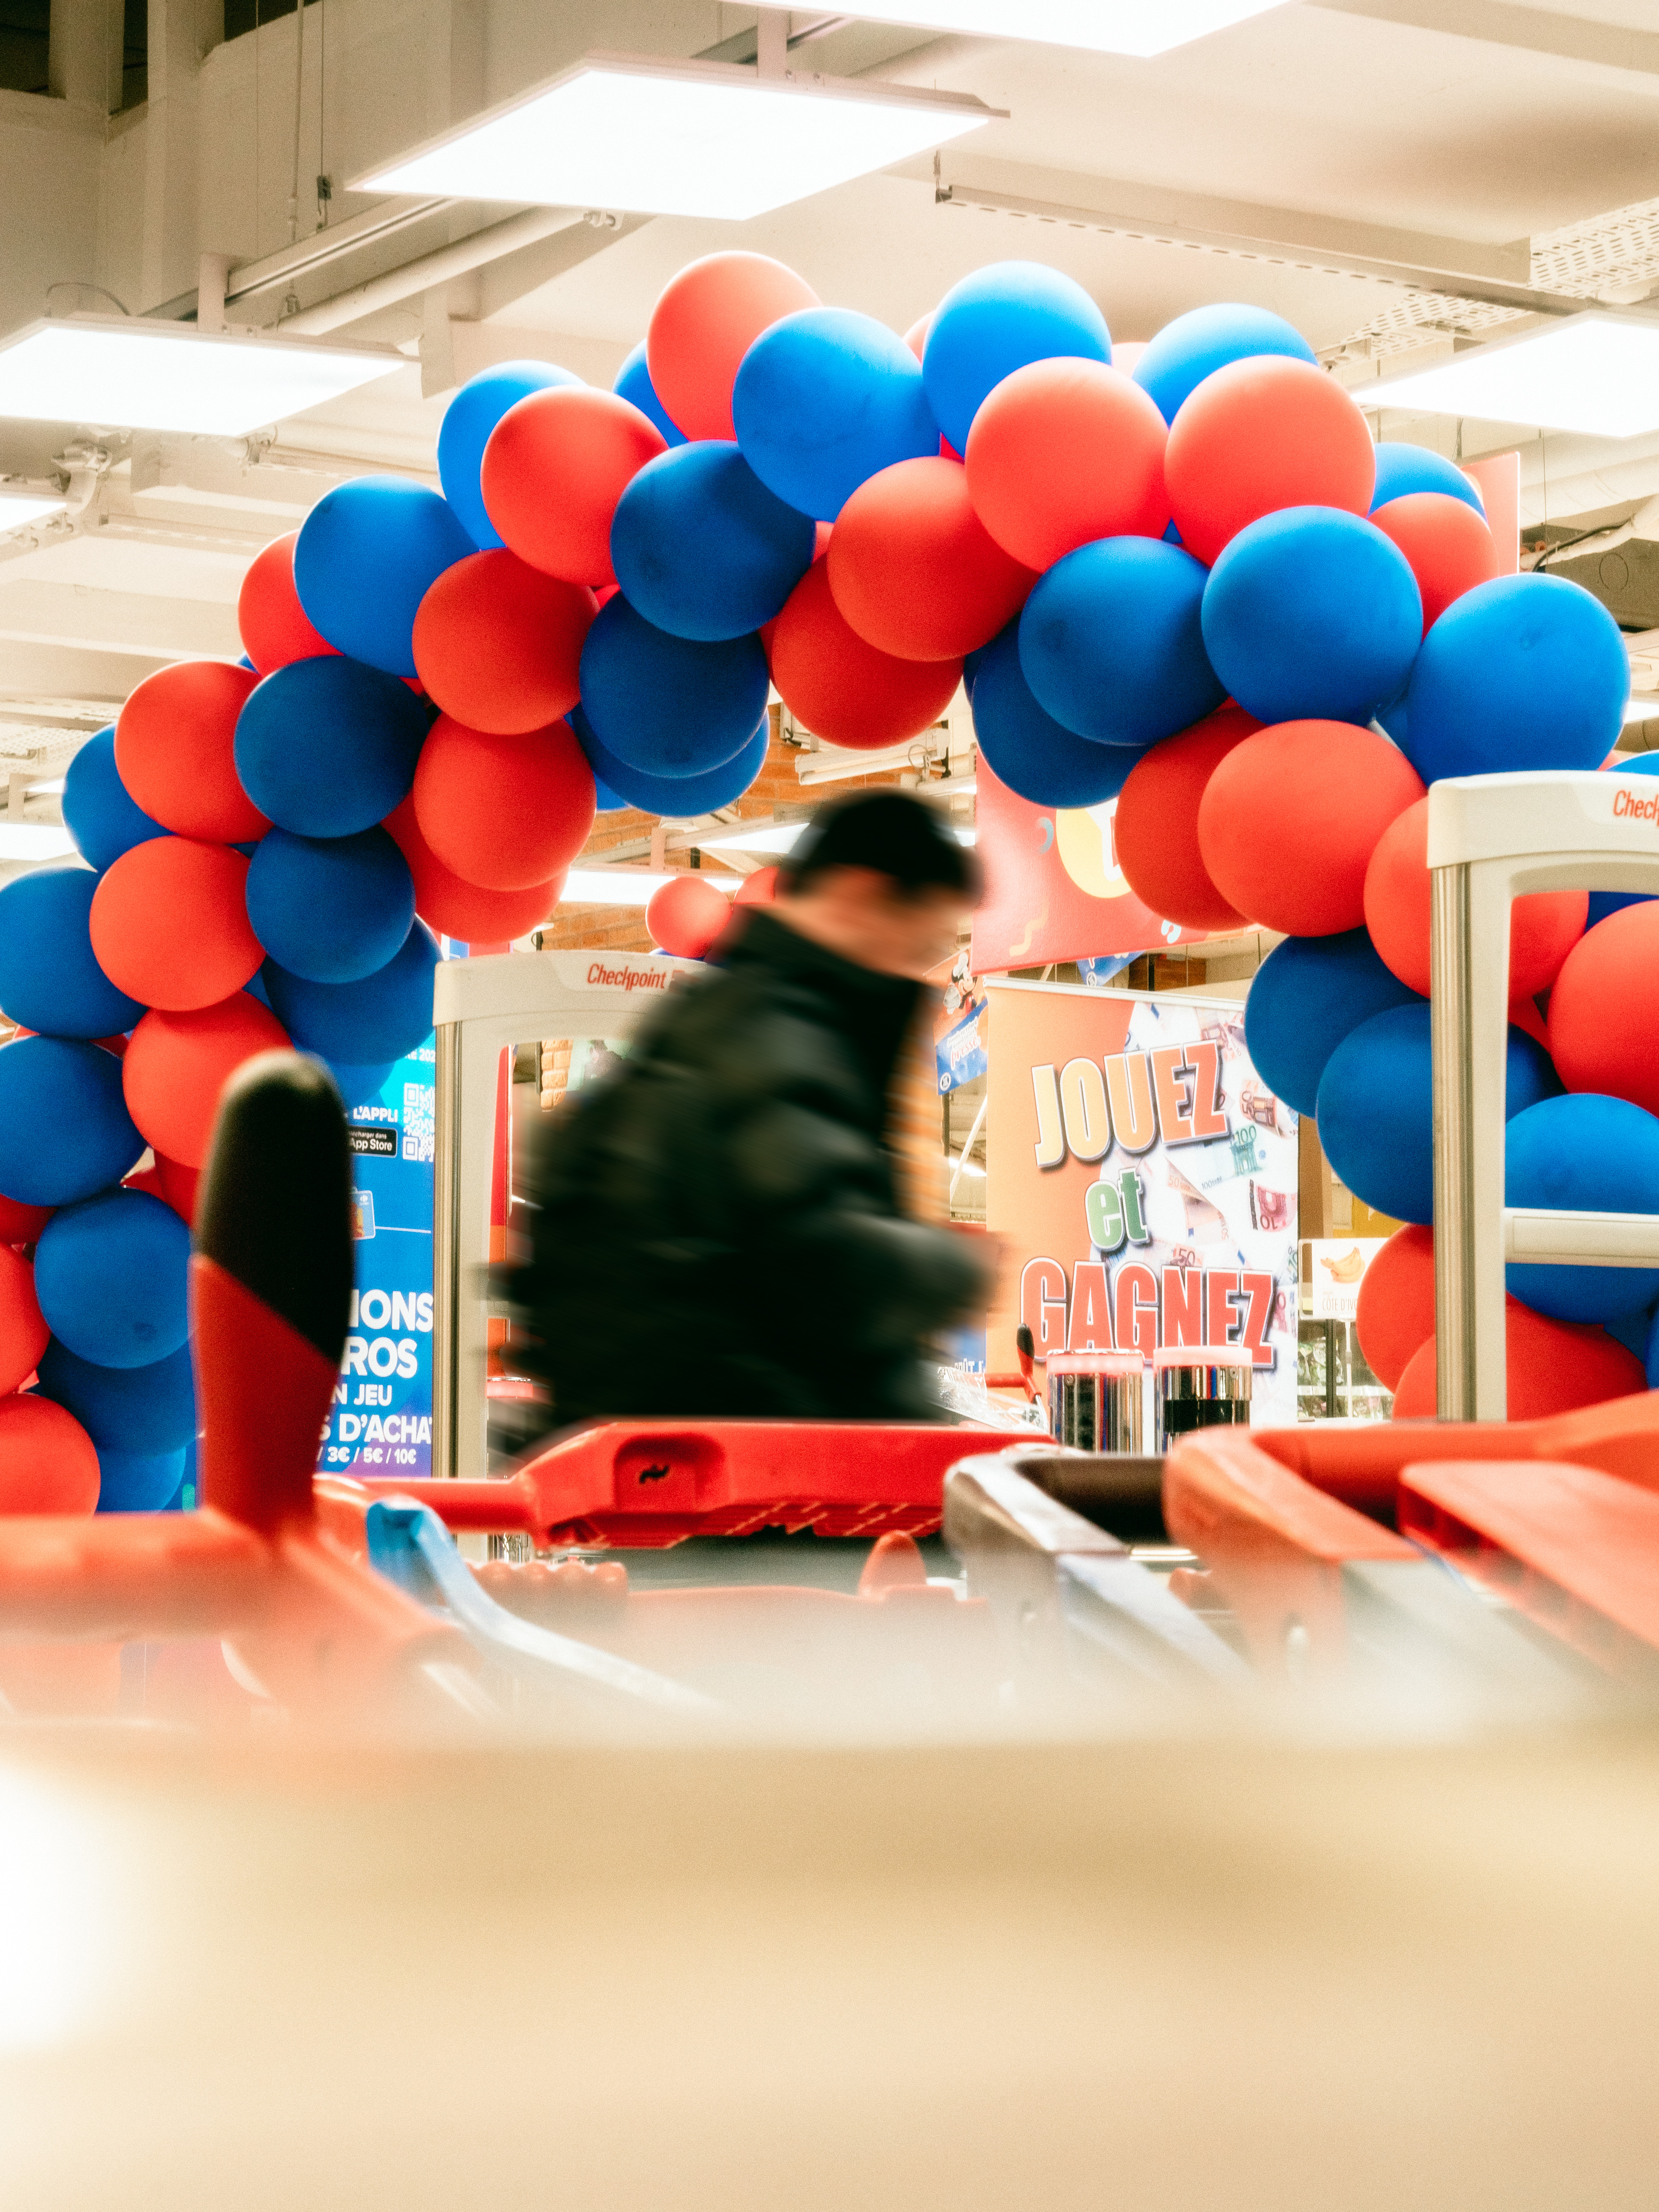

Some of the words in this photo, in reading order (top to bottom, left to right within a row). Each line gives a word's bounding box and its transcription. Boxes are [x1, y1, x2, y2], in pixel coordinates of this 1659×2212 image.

[1613, 789, 1659, 827] Check
[587, 963, 667, 991] Checkpoint
[353, 1106, 398, 1123] L'APPLI
[1031, 1039, 1230, 1168] JOUEZ
[370, 1138, 392, 1151] Store
[1086, 1167, 1150, 1250] et
[348, 1289, 433, 1333] IONS
[1020, 1257, 1275, 1367] GAGNEZ
[1322, 1295, 1338, 1311] CÔTE
[341, 1336, 418, 1379] ROS
[353, 1384, 392, 1406] JEU
[327, 1446, 350, 1463] 3€
[363, 1447, 383, 1463] 5€
[394, 1449, 416, 1464] 10€
